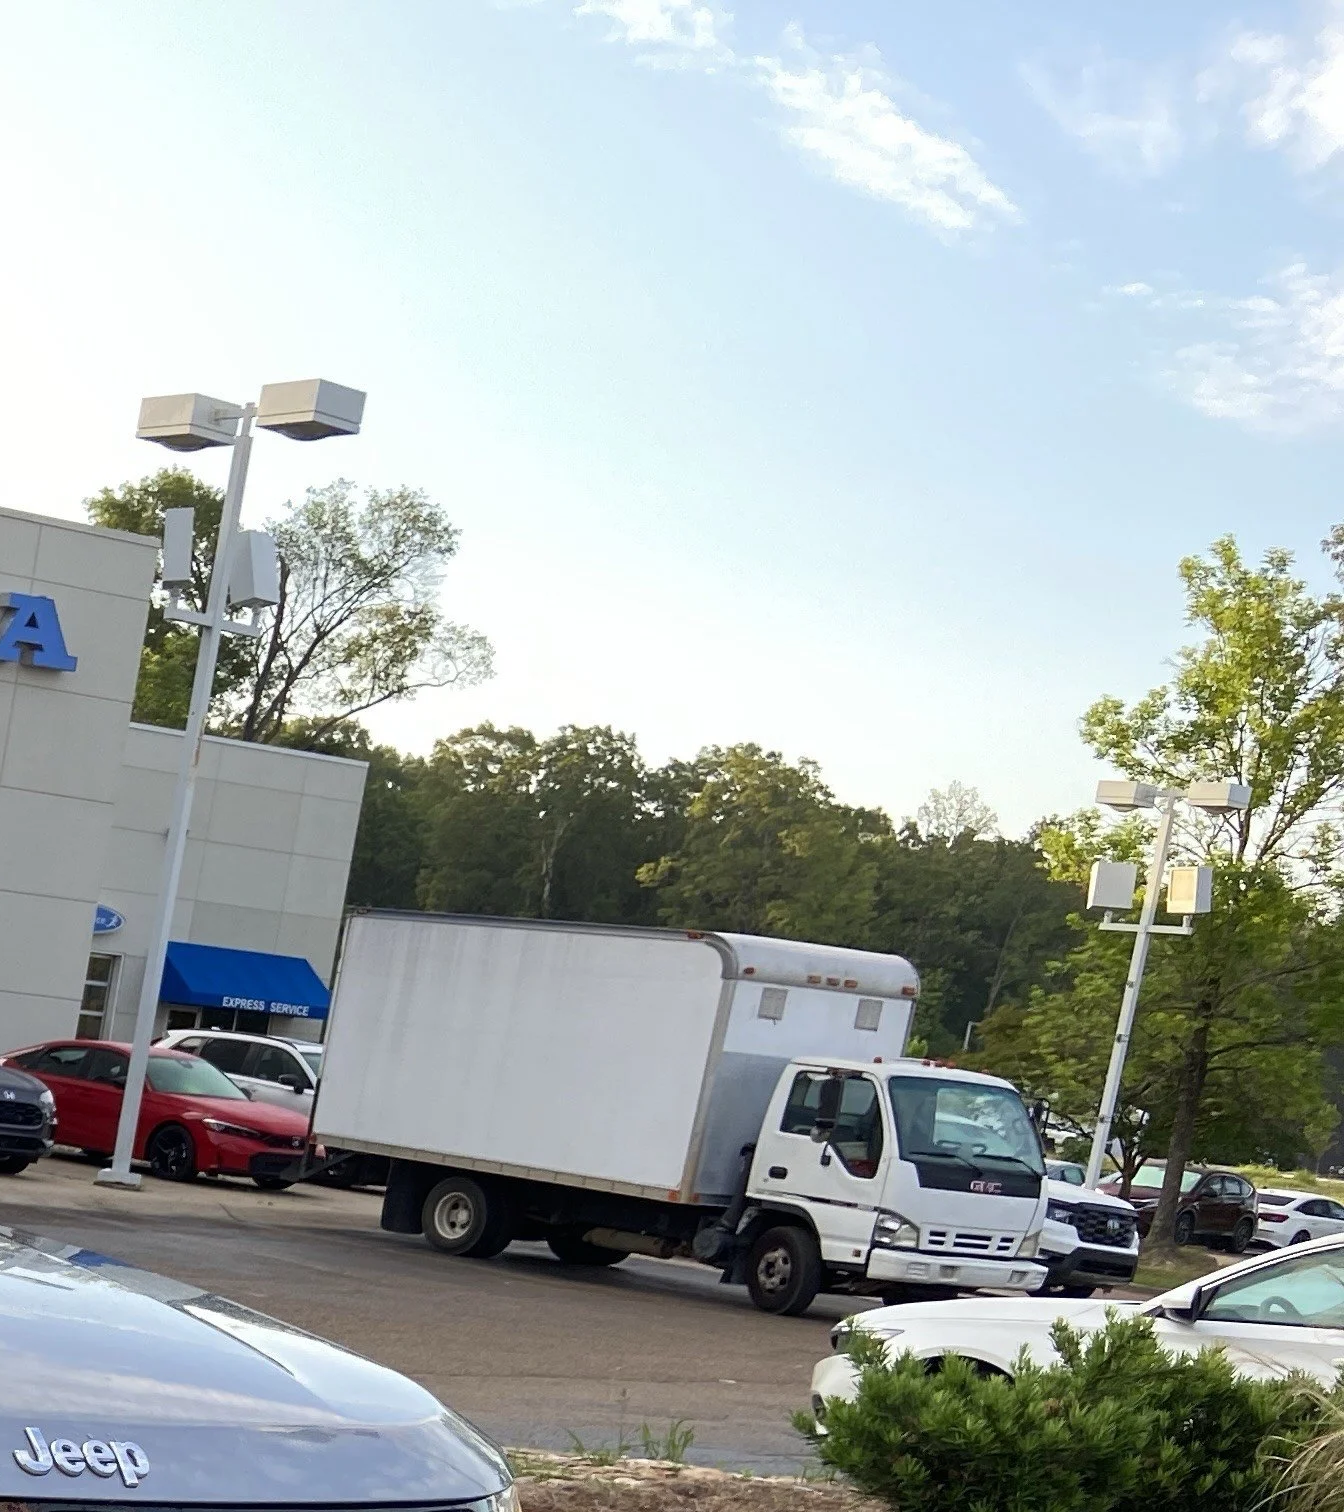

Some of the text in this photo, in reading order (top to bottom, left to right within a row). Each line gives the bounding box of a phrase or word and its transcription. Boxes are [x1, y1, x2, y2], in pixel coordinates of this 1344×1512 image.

[222, 996, 310, 1016] EXPRESS SERVICE
[12, 1426, 151, 1488] Jeep
